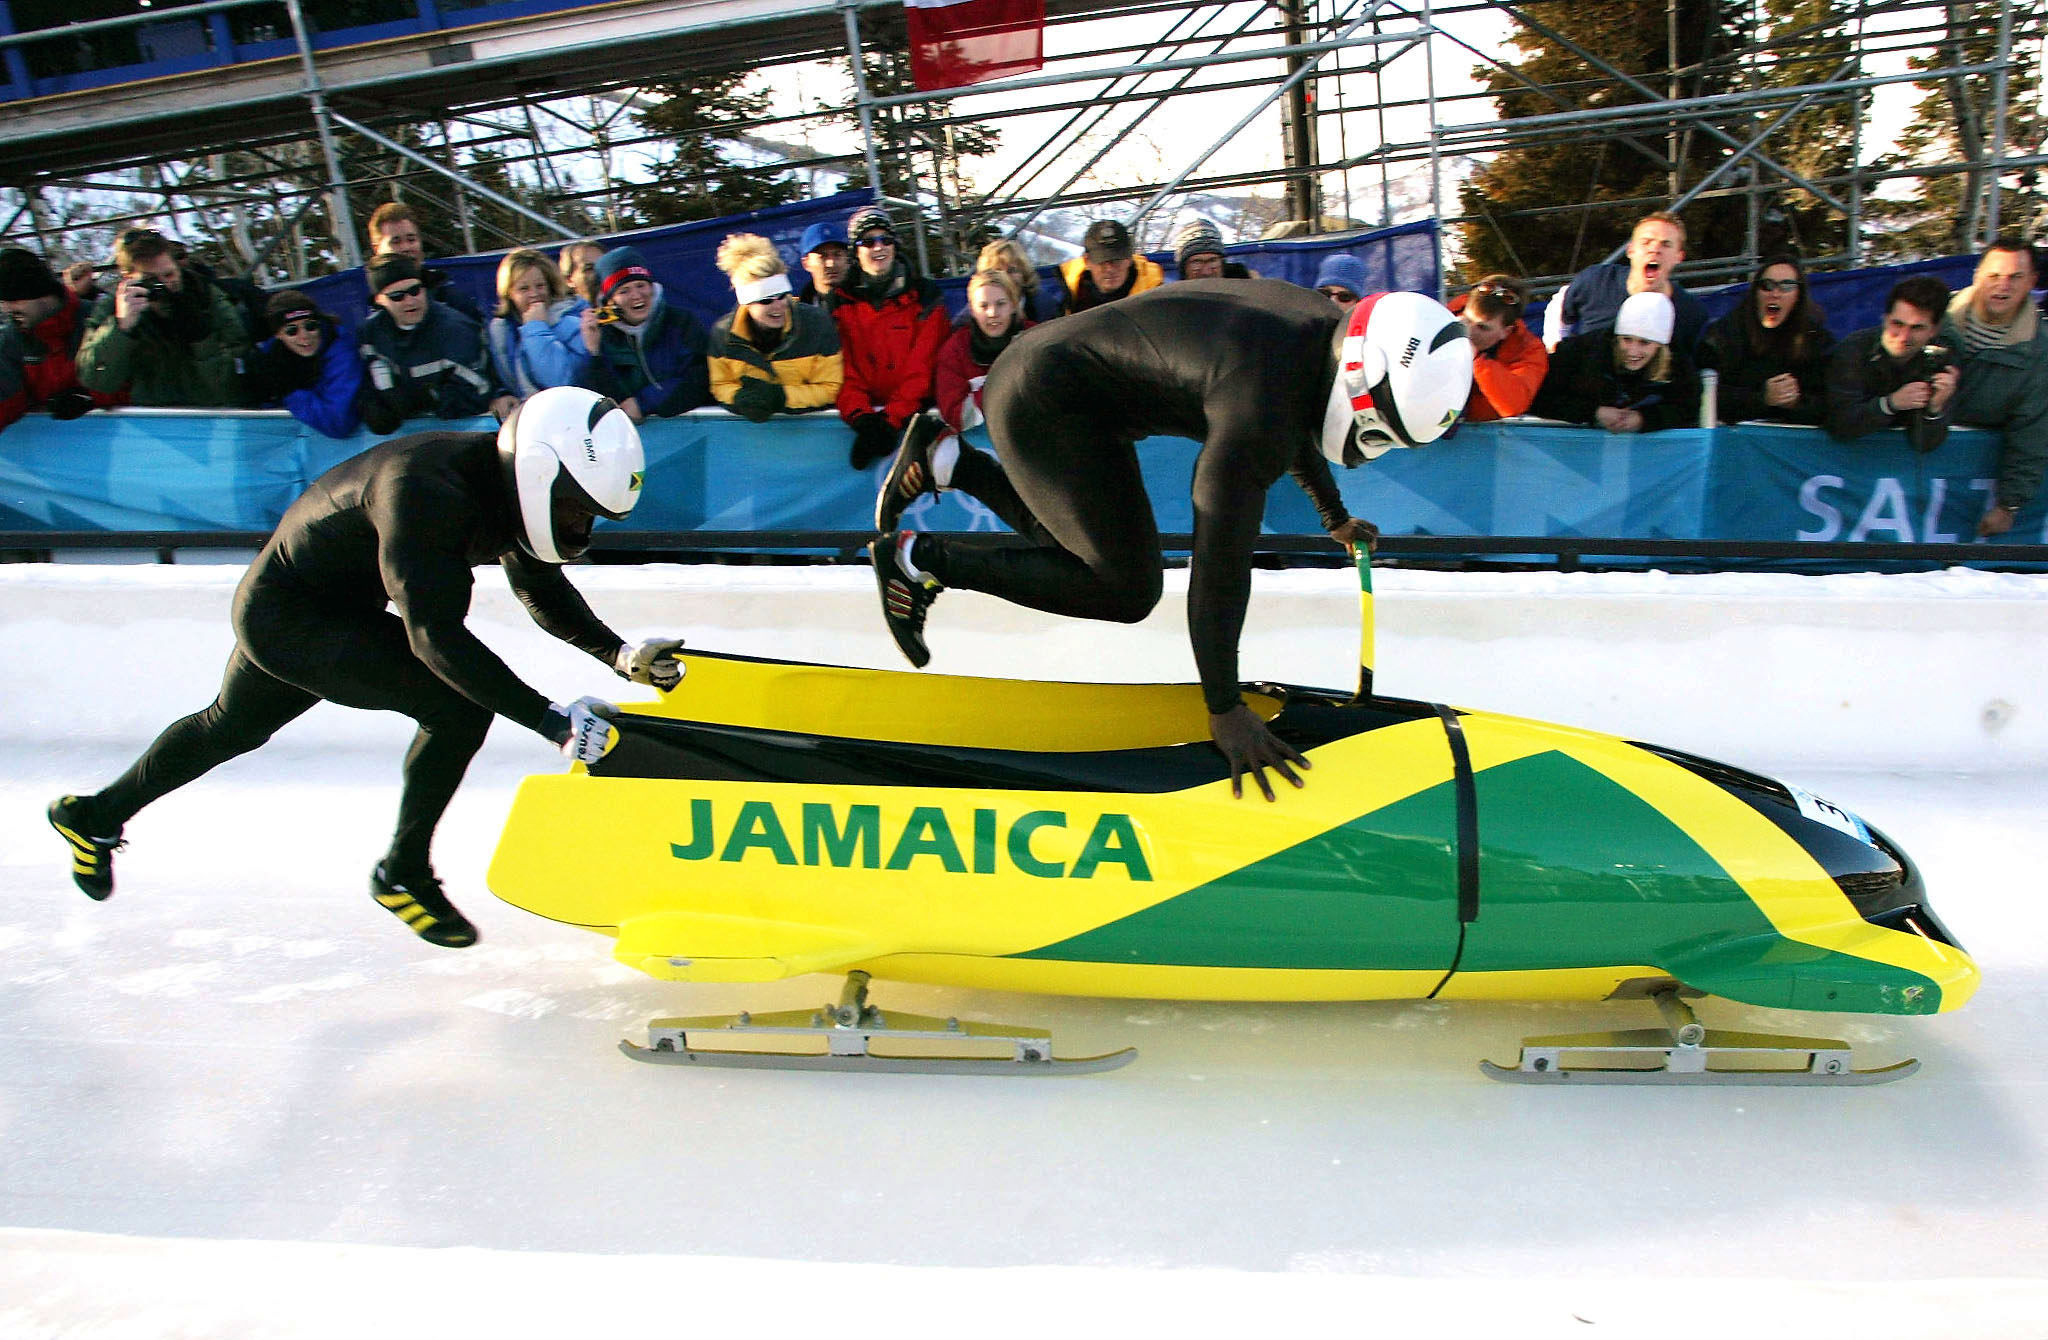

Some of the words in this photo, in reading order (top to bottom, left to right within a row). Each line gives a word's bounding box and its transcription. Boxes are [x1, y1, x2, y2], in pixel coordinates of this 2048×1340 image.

[1399, 336, 1422, 369] BMW
[583, 438, 597, 462] BMW
[576, 716, 597, 761] reusch
[670, 798, 1155, 882] JAMAICA
